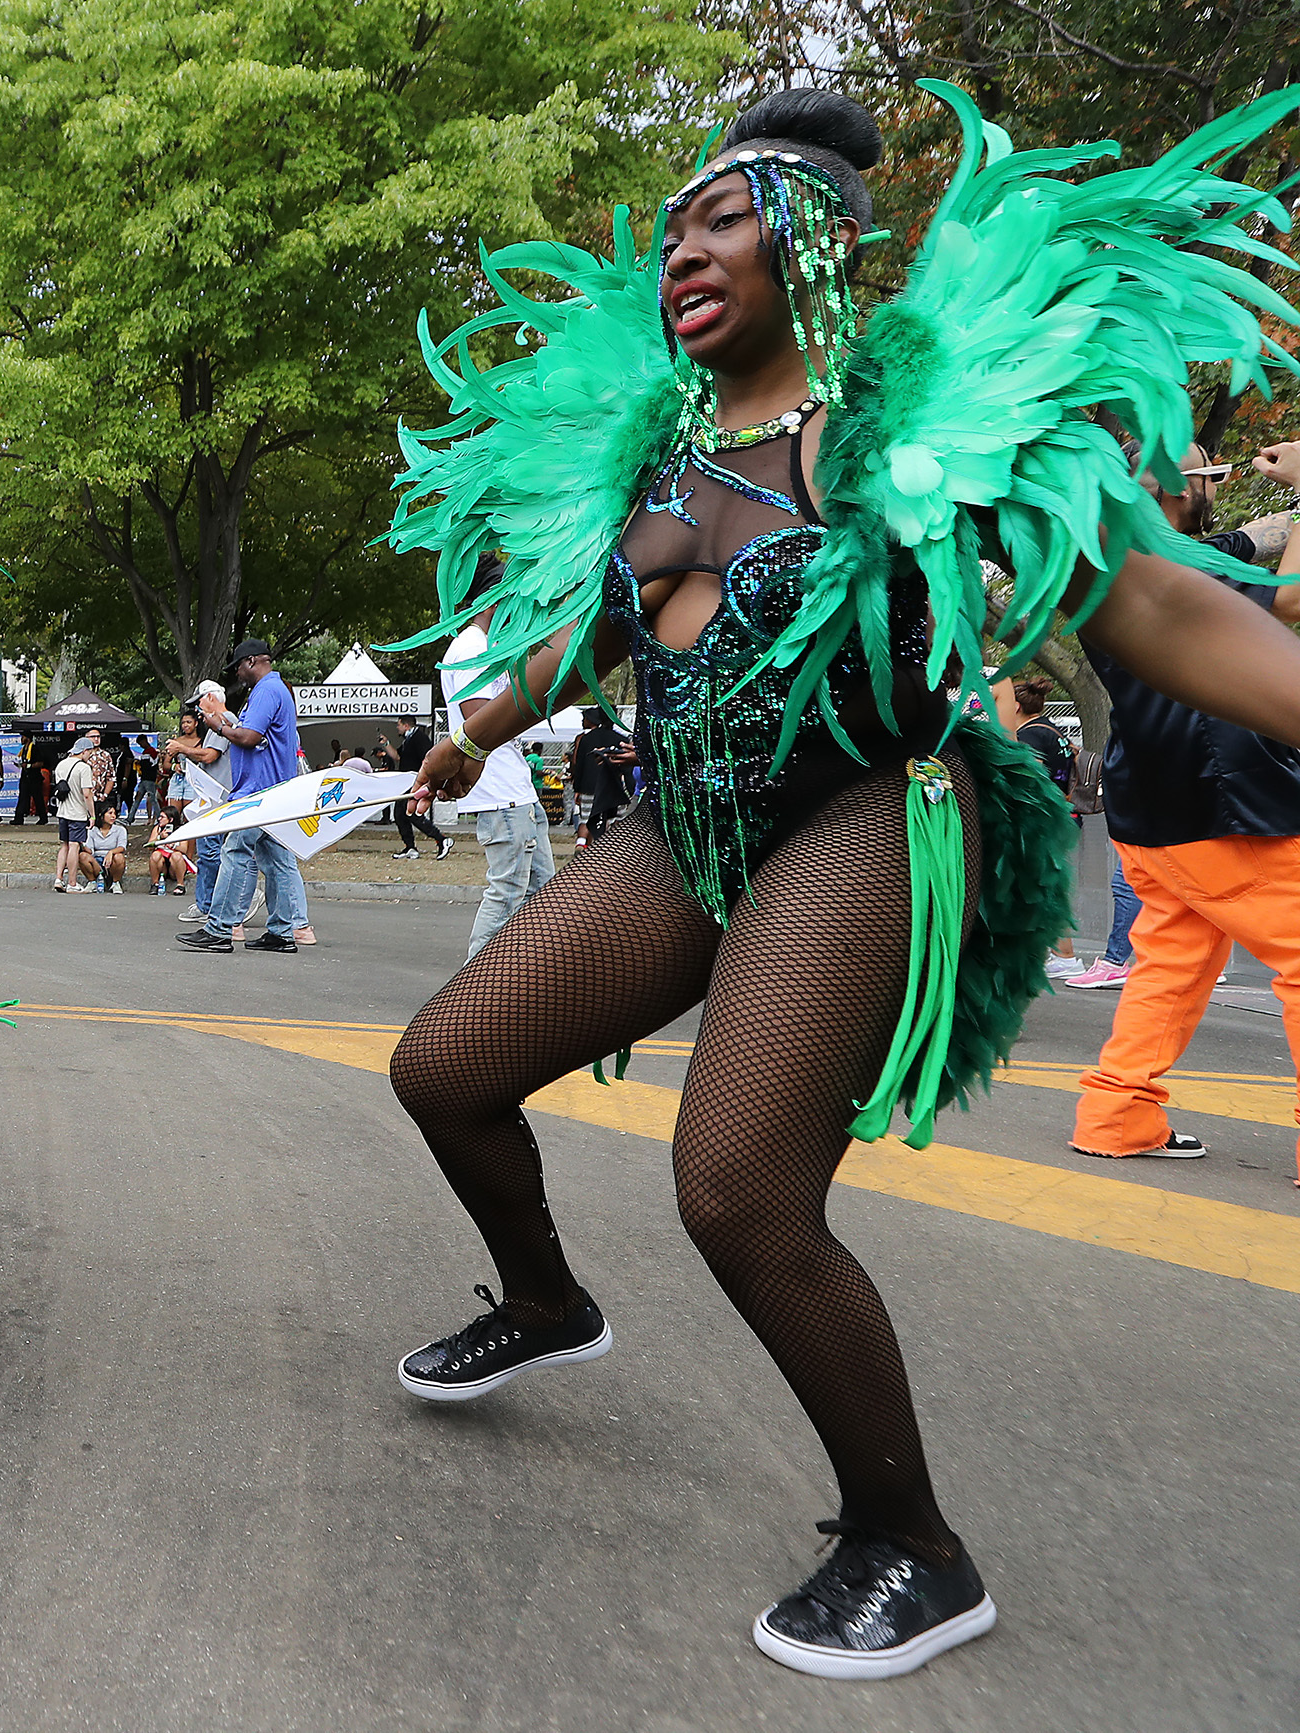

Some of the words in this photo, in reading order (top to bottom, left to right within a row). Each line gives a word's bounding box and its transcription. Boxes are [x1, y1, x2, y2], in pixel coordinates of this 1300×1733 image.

[299, 687, 337, 699] CASH
[341, 686, 419, 699] EXCHANGE
[299, 703, 322, 714] 21+
[325, 702, 419, 714] WRISTBANDS
